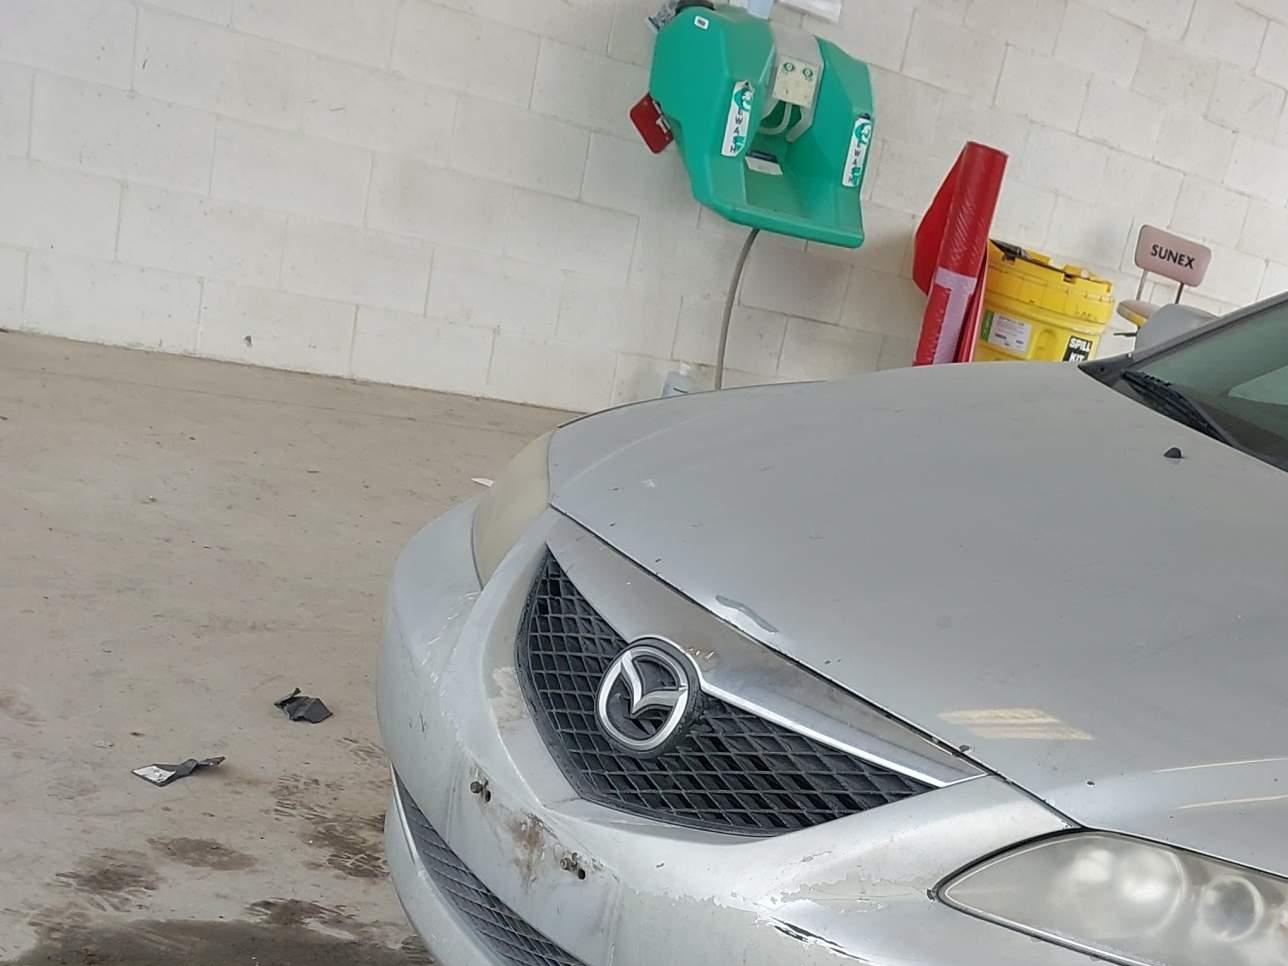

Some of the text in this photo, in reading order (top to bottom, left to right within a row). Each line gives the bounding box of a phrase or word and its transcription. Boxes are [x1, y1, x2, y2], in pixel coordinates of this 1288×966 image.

[1151, 244, 1195, 269] SUNEX
[1069, 337, 1092, 352] SPILL
[1069, 352, 1085, 362] KIT
